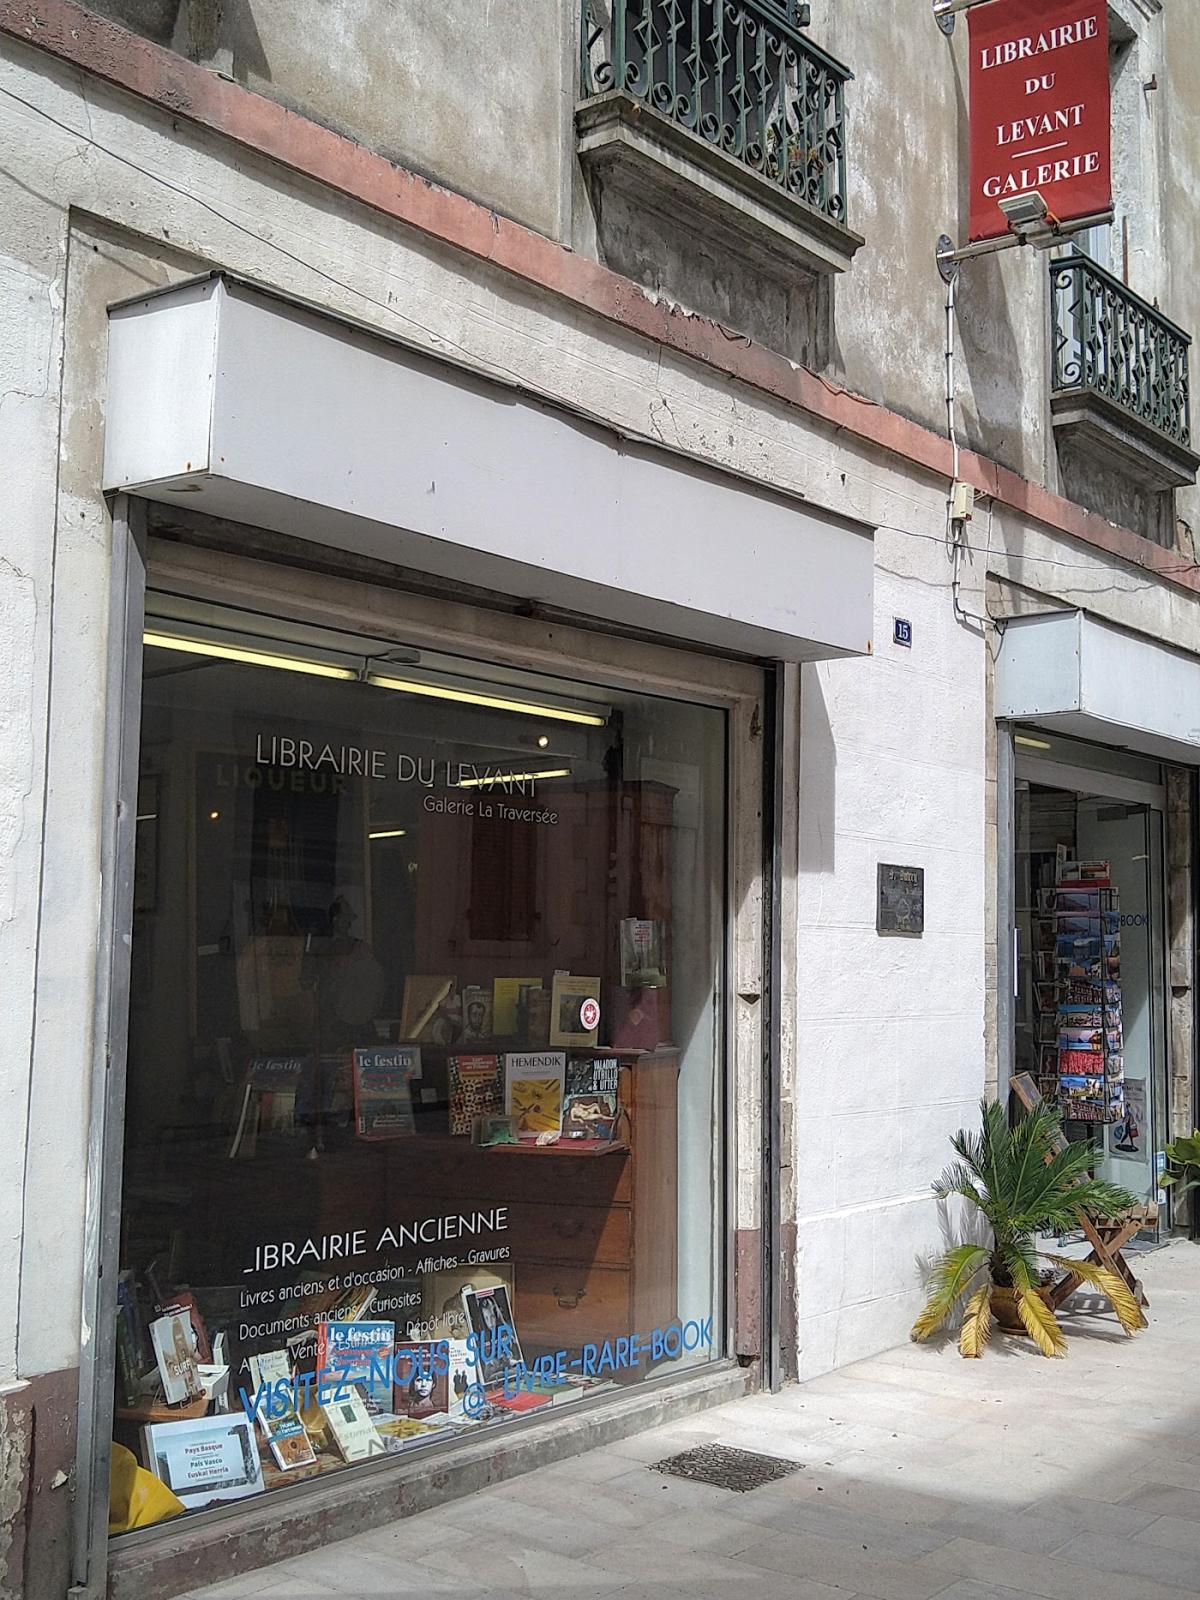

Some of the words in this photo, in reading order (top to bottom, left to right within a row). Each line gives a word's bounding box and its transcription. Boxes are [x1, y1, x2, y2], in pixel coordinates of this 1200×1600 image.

[981, 16, 1098, 70] LIBRAIRIE
[1025, 73, 1056, 95] DU
[997, 104, 1085, 145] LEVANT
[983, 152, 1099, 198] GALERIE
[897, 623, 909, 640] 15
[257, 734, 386, 779] LIBRAIRIE
[398, 754, 435, 784] DU
[446, 761, 539, 798] LEVANT
[423, 795, 474, 816] Galerie
[479, 801, 493, 818] La
[497, 803, 558, 825] Traversée
[359, 1055, 372, 1067] le
[511, 1056, 562, 1067] HEMENDIK
[600, 1080, 618, 1090] UTTER
[376, 1207, 508, 1251] ANCIENNE
[240, 1290, 275, 1308] Livres
[278, 1280, 324, 1300] anciens
[328, 1275, 340, 1290] et
[343, 1265, 405, 1288] d'occasion
[415, 1256, 458, 1276] Affiches
[467, 1246, 510, 1265] Gravures
[239, 1314, 310, 1341] Documents
[313, 1304, 357, 1326] anciens
[329, 1327, 344, 1342] le
[407, 1313, 439, 1337] Dépôt
[239, 1340, 449, 1423] VISITEZ-NOUS
[466, 1323, 513, 1367] SUR
[463, 1383, 486, 1419] @
[502, 1316, 714, 1401] LIVRE-RARE-BOOK
[204, 1458, 223, 1466] Vasco
